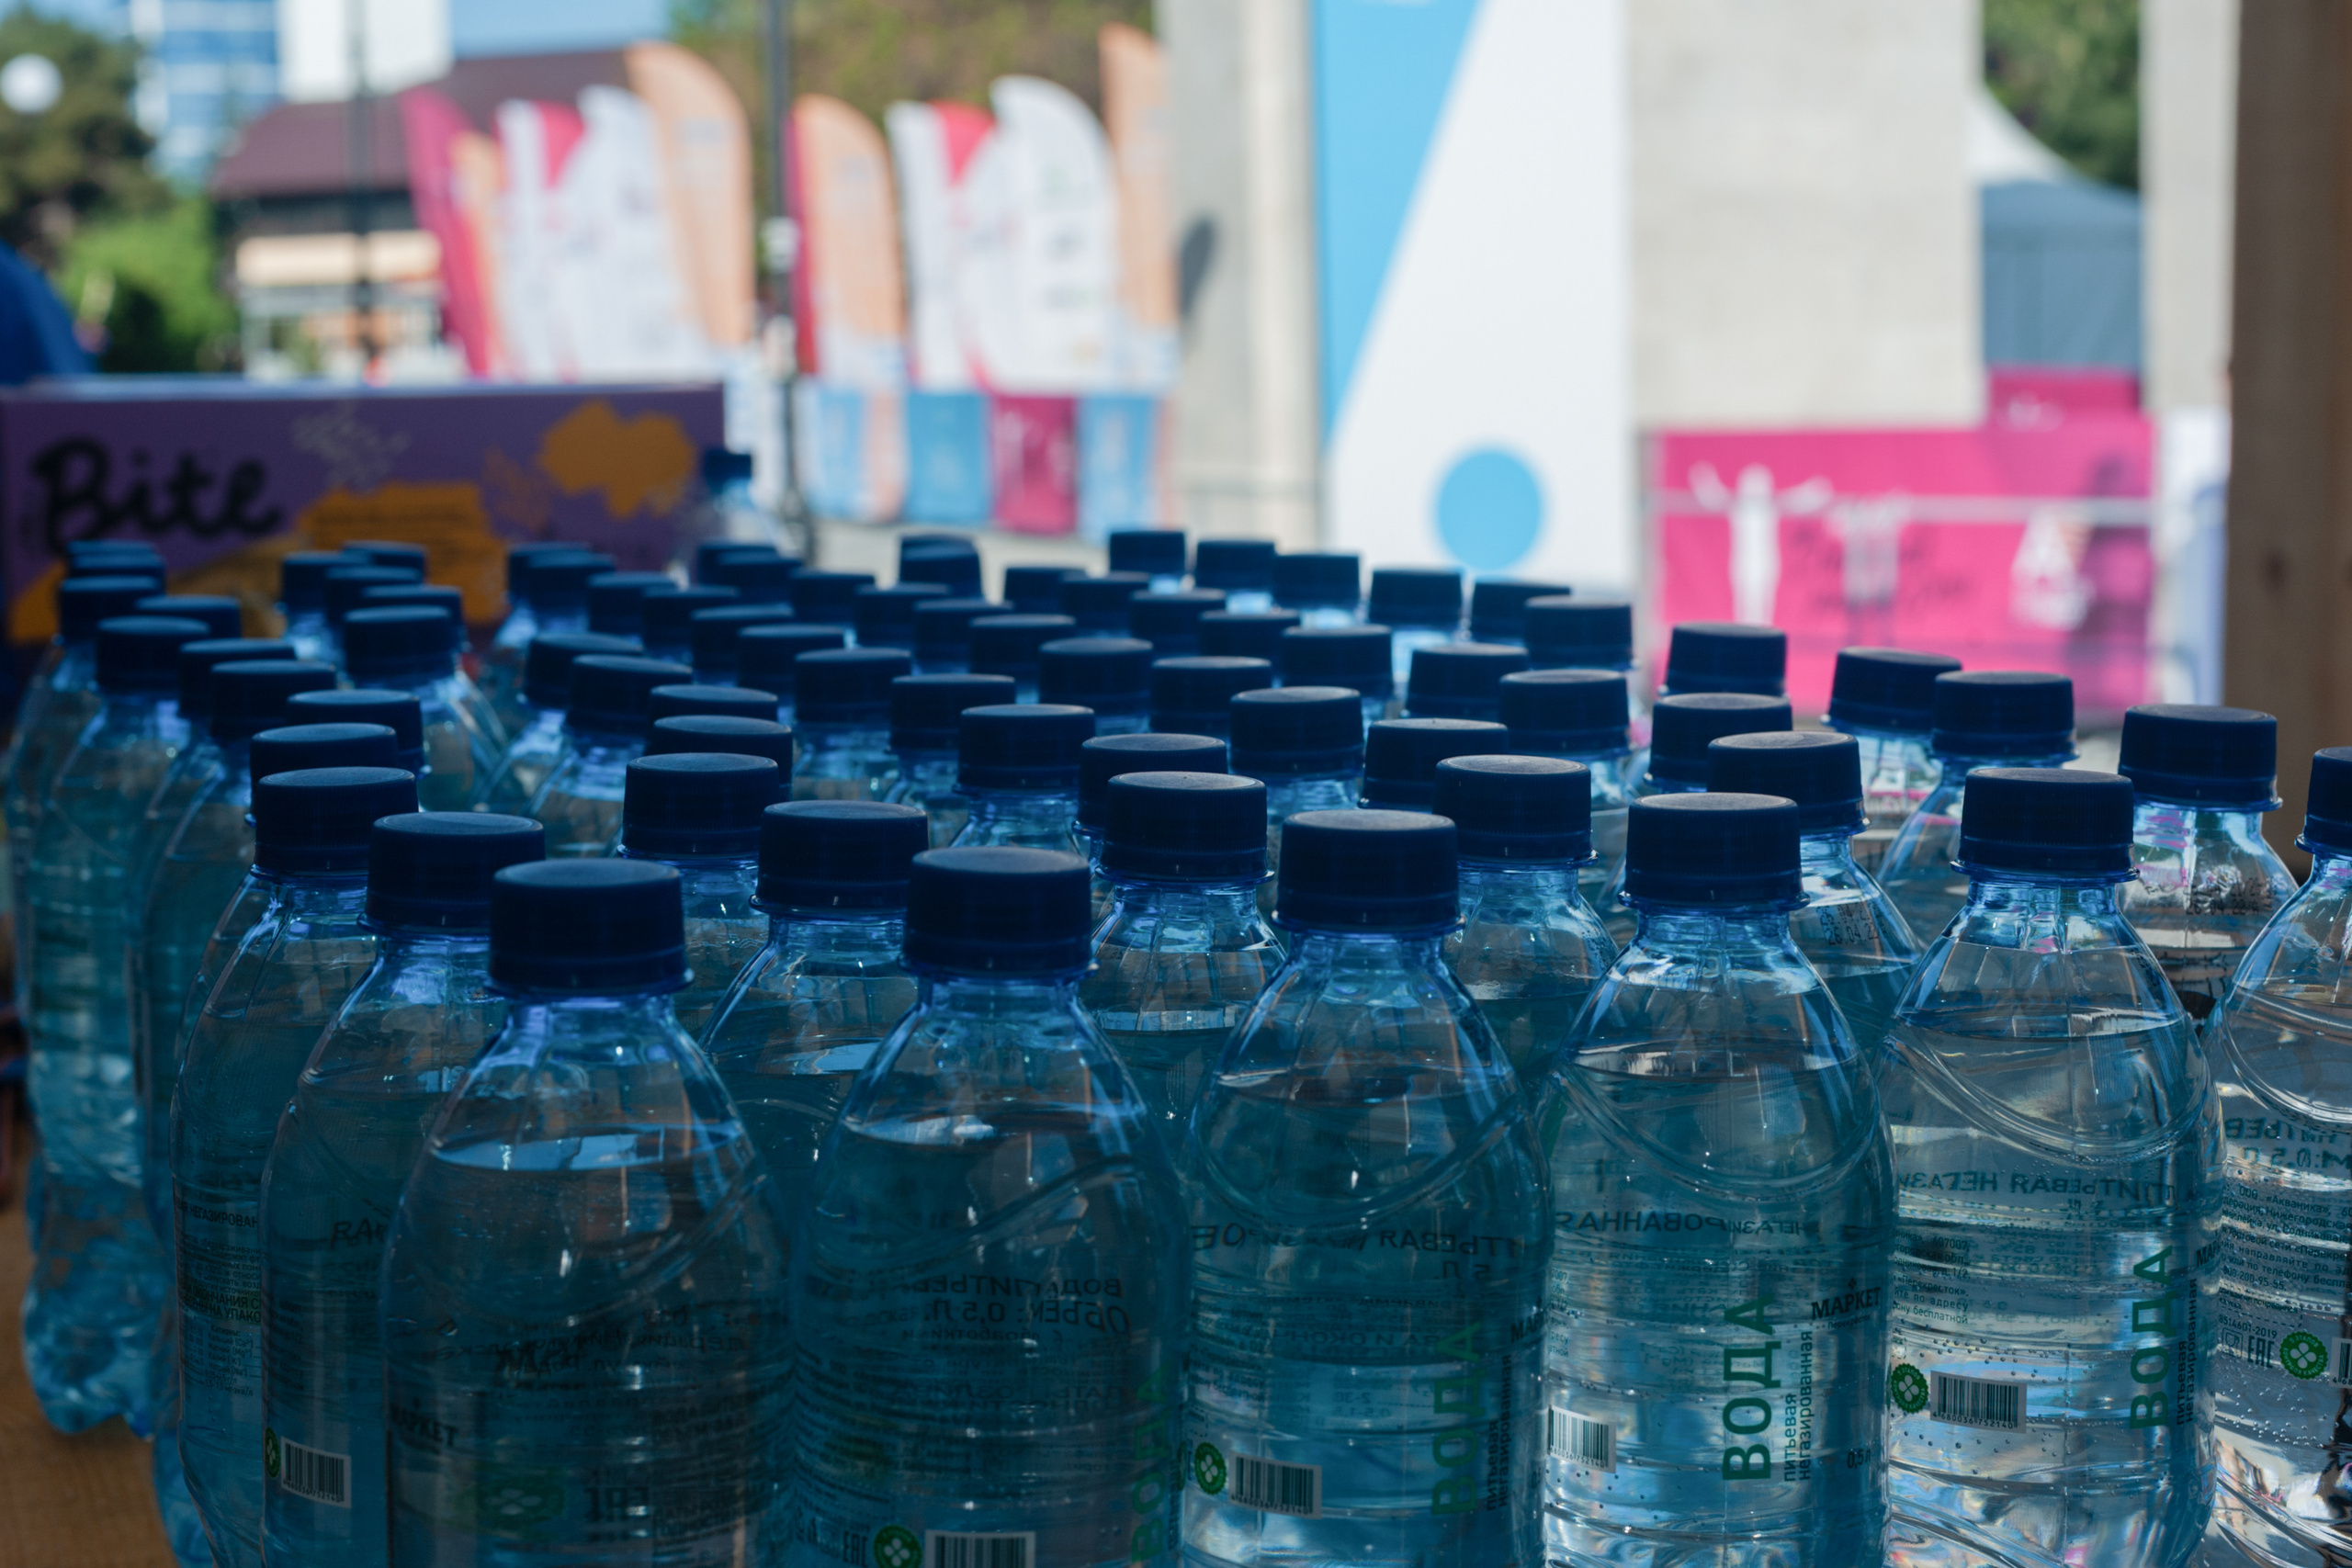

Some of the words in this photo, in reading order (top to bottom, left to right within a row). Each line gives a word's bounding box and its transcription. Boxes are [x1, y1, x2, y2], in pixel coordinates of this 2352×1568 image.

[33, 437, 281, 554] Bite
[2266, 1195, 2332, 1216] «Акваника»,
[1914, 1293, 1926, 1303] по
[1930, 1297, 1969, 1312] адресу
[2239, 1246, 2308, 1269] направляйте
[2314, 1263, 2329, 1273] по
[2262, 1265, 2310, 1284] телефону
[1811, 1286, 1883, 1321] МАРКЕТ
[1913, 1304, 1969, 1325] бесплатной
[2130, 1246, 2177, 1429] ВОДА
[1722, 1292, 1781, 1481] ВОДА
[2177, 1340, 2188, 1426] питьевая
[2186, 1278, 2198, 1423] негазированная
[1432, 1322, 1487, 1516] ВОДА
[1784, 1393, 1797, 1482] питьевая
[1798, 1331, 1813, 1481] негазированная
[1847, 1448, 1864, 1470] 0,5
